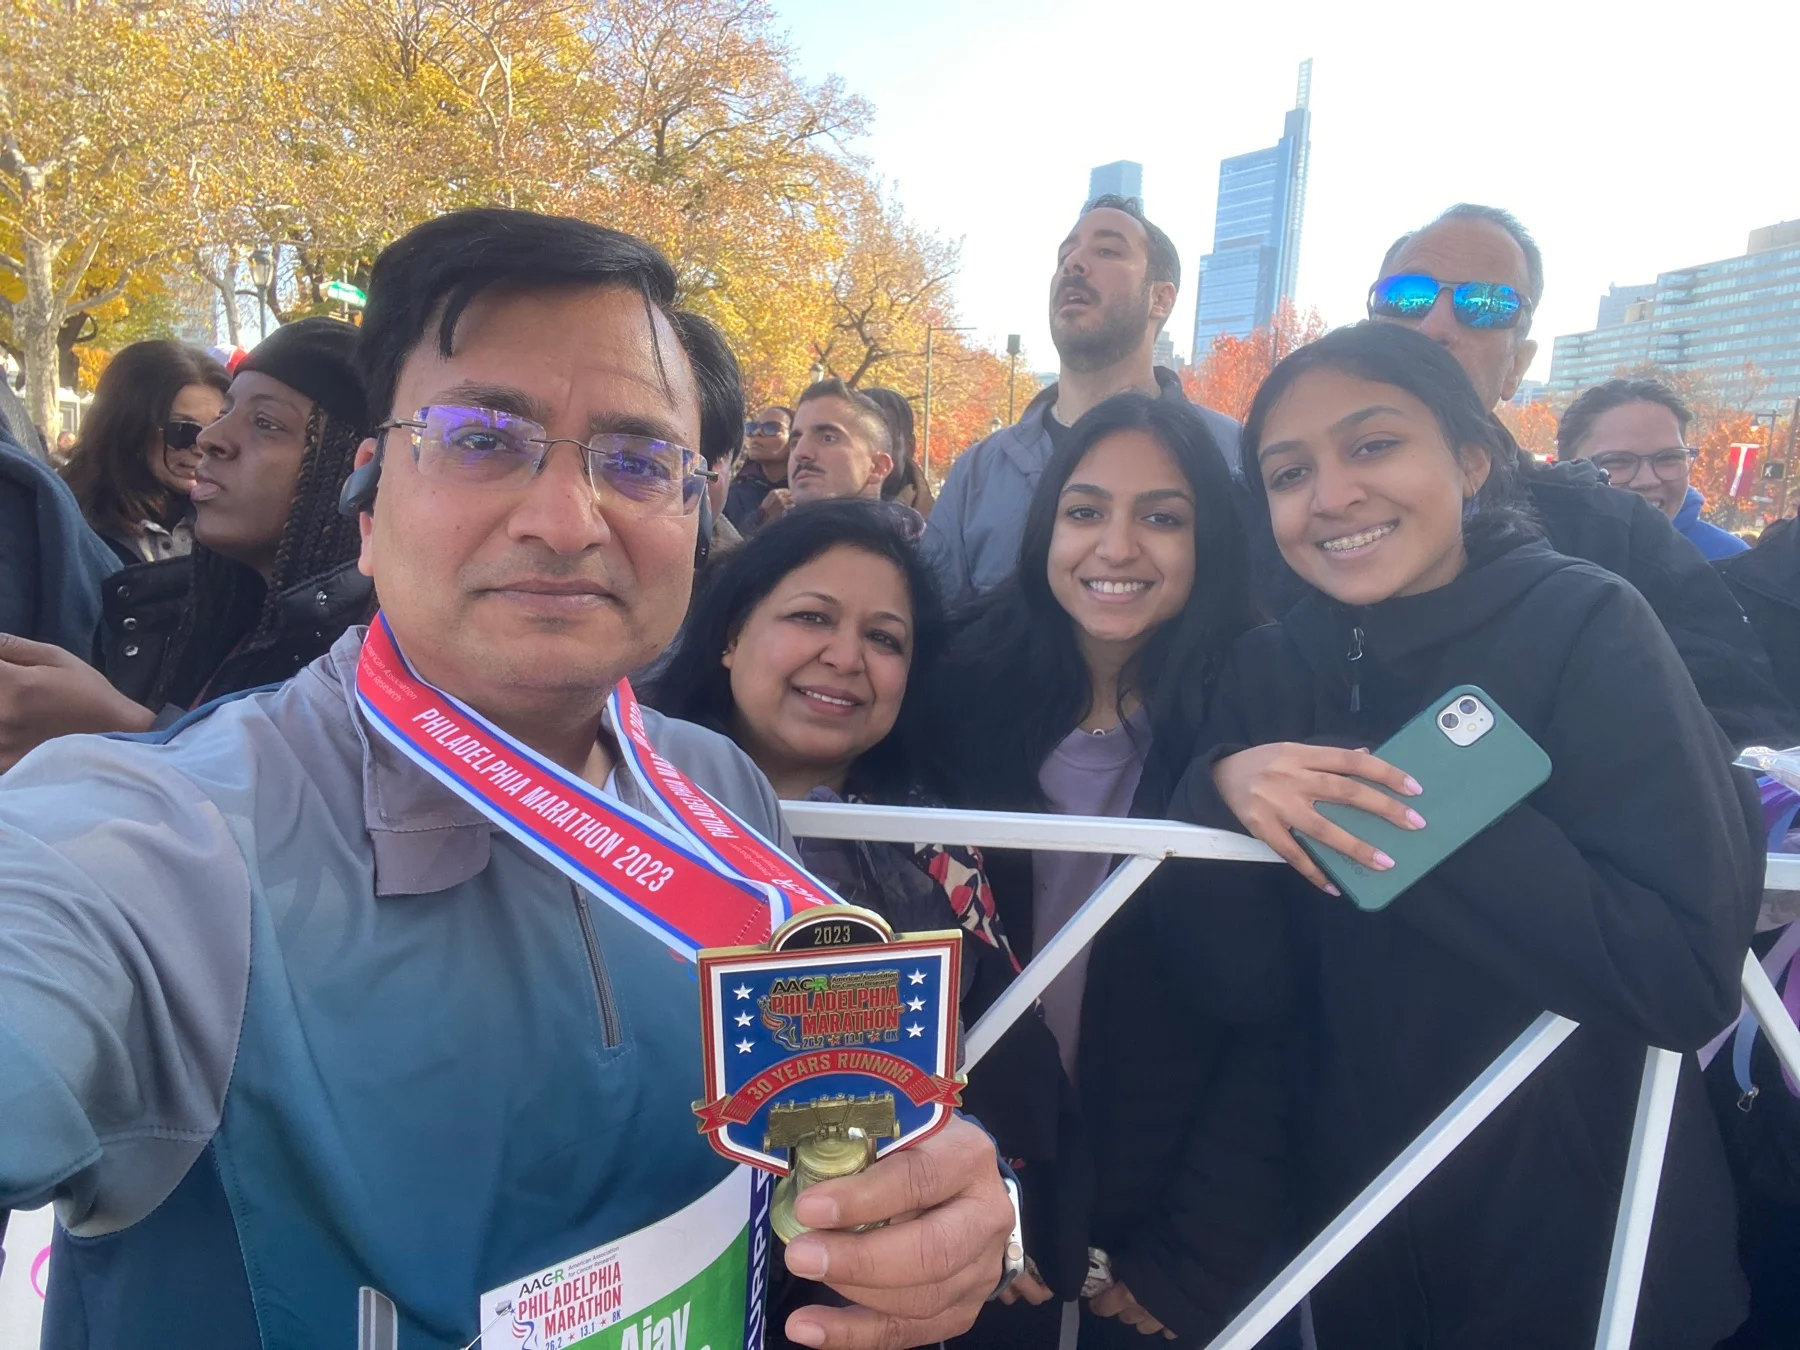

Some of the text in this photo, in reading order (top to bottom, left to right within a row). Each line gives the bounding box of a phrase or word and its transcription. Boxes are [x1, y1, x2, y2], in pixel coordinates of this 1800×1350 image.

[411, 707, 675, 892] PHILADELPHIA MARATHON 2023
[814, 924, 851, 946] 2023
[770, 985, 899, 1015] PHILADELPHIA
[771, 975, 829, 995] AACR
[801, 1007, 899, 1036] MARATHON
[749, 1052, 914, 1100] 30 YEARS RUNNING
[518, 1261, 621, 1321] PHILADELPHIA
[519, 1268, 565, 1299] AACR
[544, 1284, 622, 1340] MARATHON
[580, 1321, 595, 1338] 13.1
[612, 1309, 622, 1323] 8K
